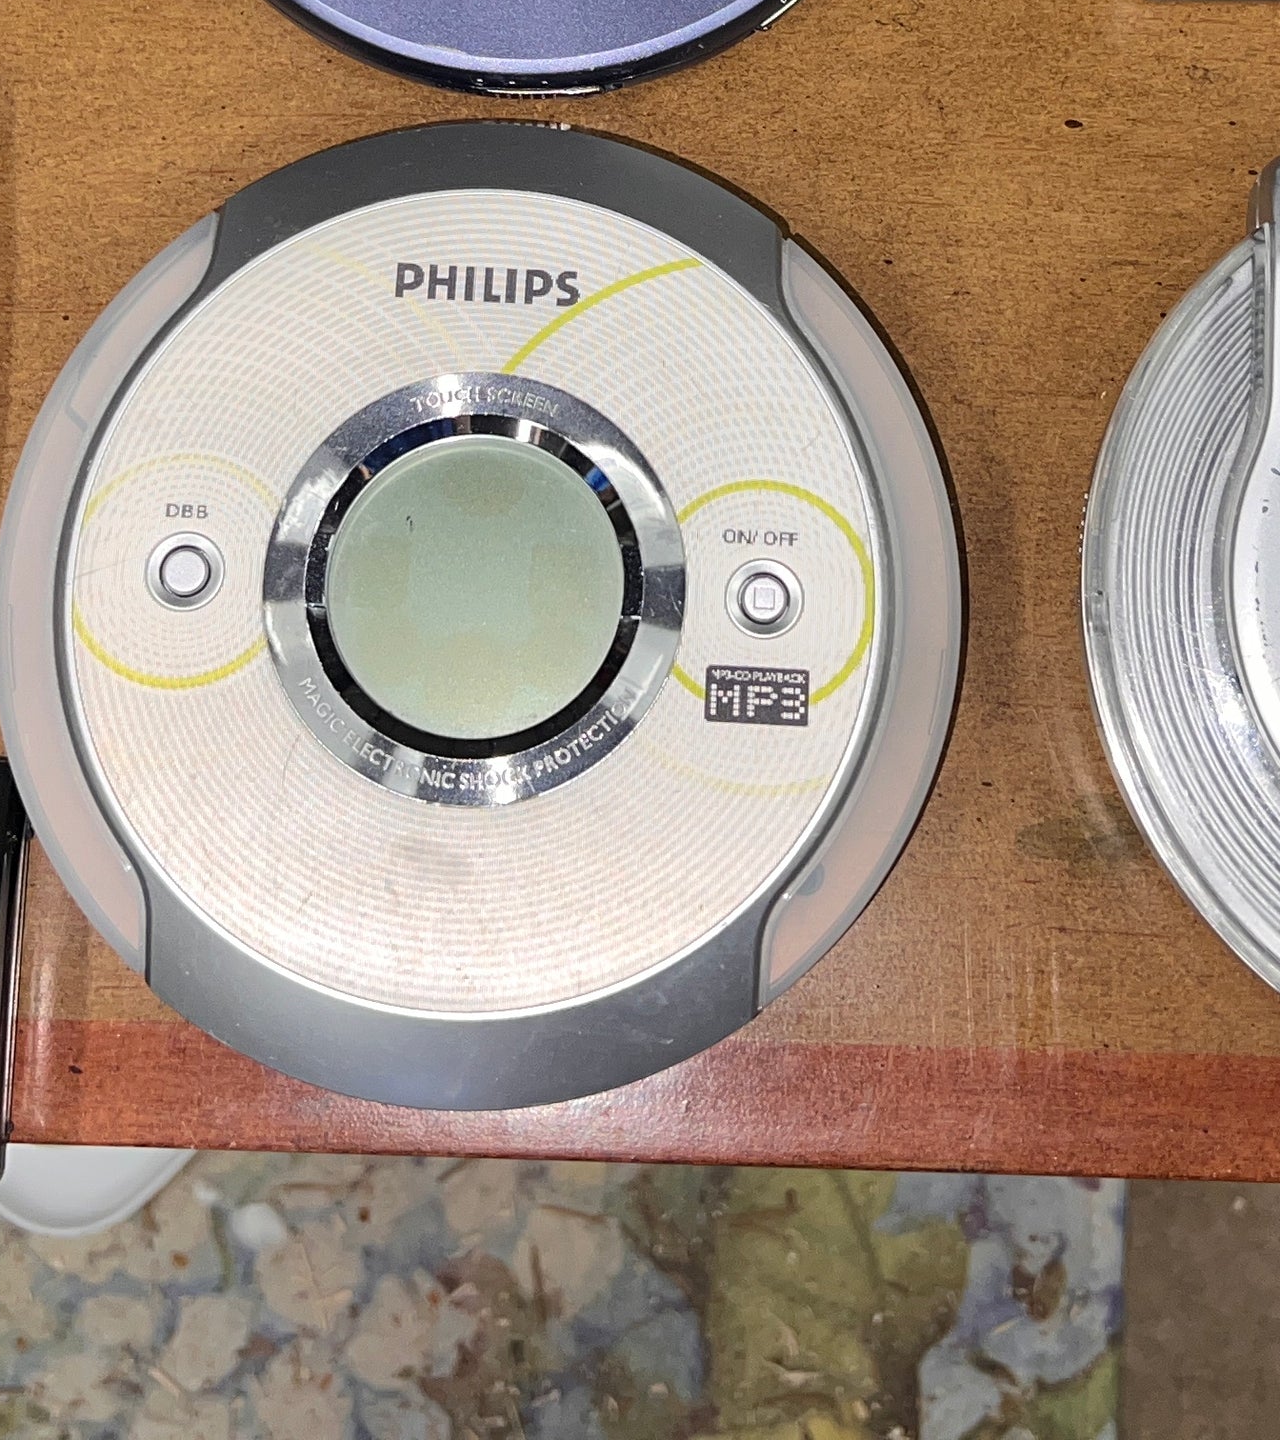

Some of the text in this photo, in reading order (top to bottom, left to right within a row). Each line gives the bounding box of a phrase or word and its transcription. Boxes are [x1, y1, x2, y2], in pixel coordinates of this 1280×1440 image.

[395, 263, 580, 307] PHILIPS
[409, 387, 560, 418] TOUCH SCREEN
[764, 530, 798, 546] OFF
[710, 683, 806, 720] MP3
[298, 676, 641, 790] MAGIC ELECTRONIC SHOCK PROTECTION
